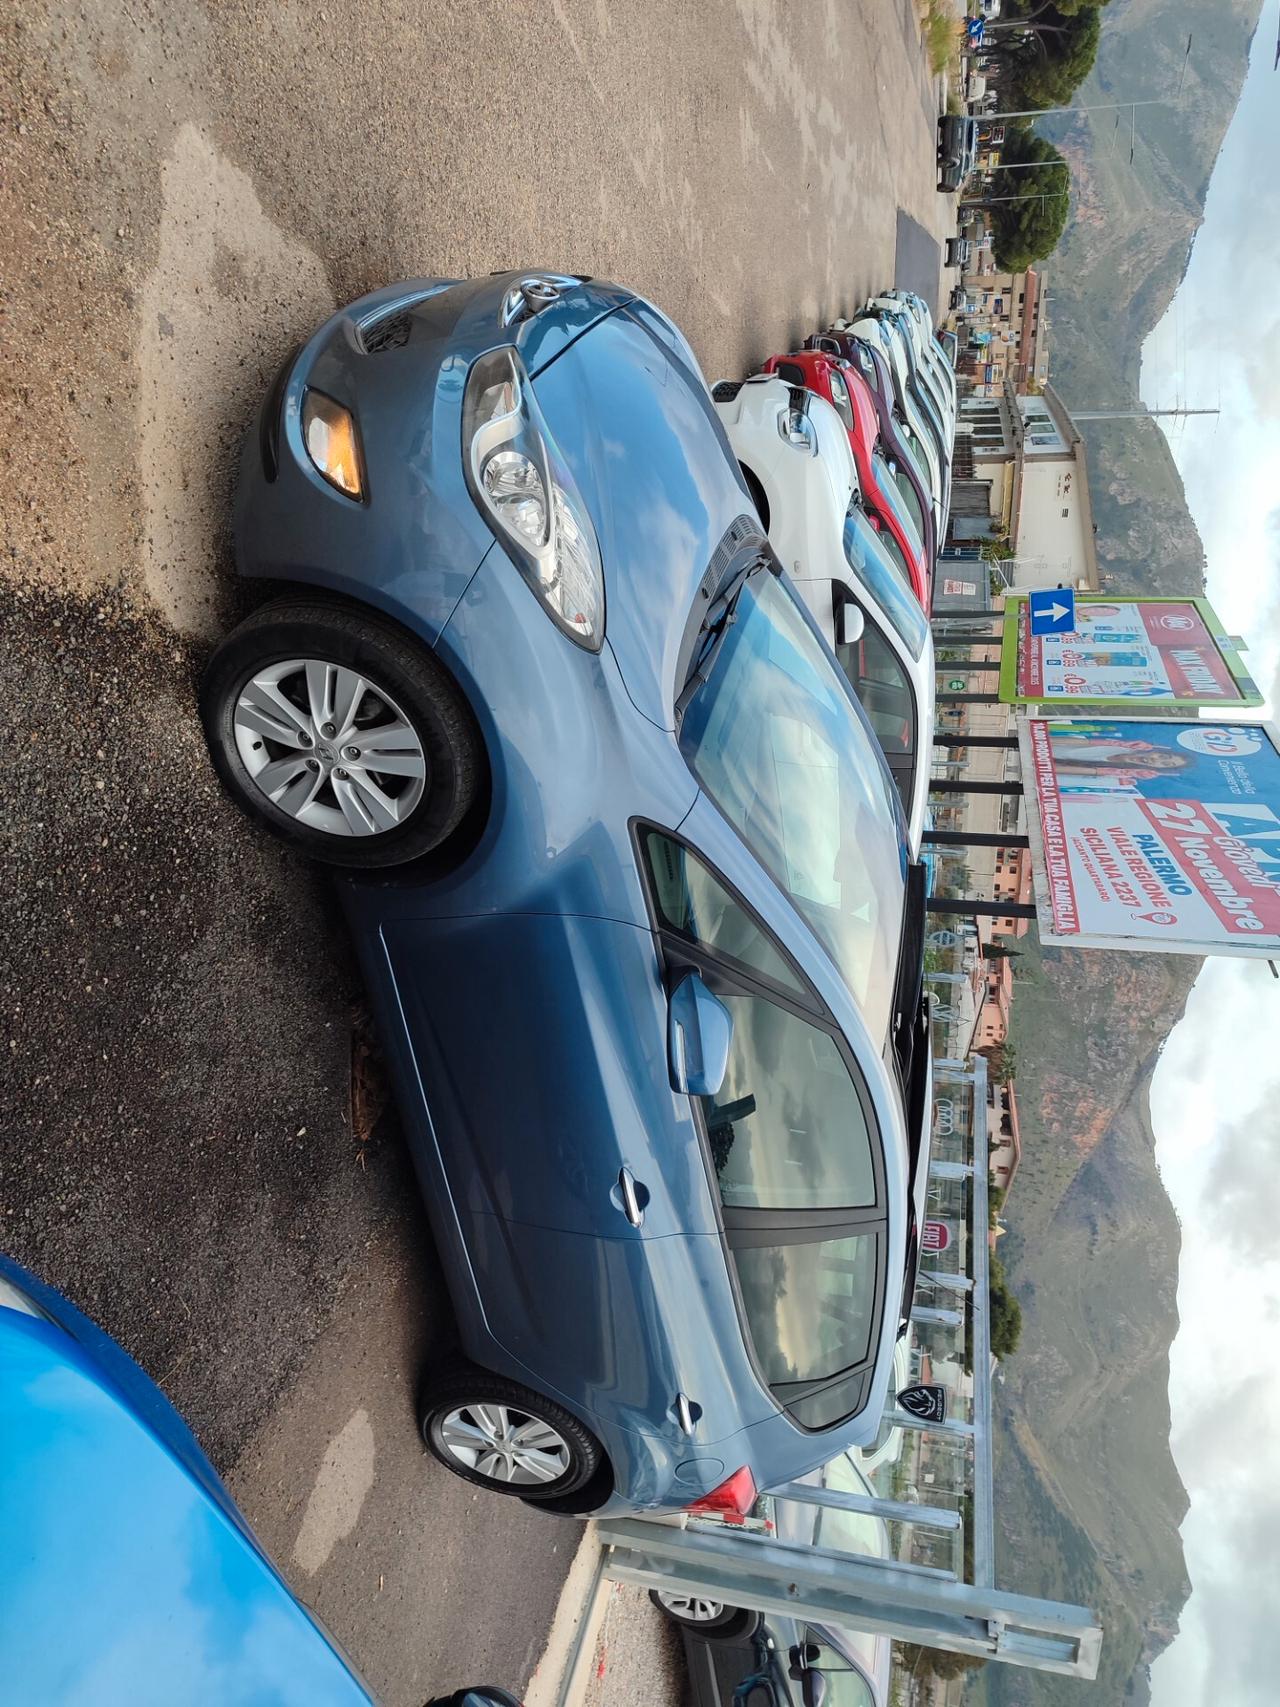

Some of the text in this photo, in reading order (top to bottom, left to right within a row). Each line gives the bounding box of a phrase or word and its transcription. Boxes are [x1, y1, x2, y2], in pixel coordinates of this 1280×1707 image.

[1035, 740, 1052, 772] PRODOTTI
[1040, 773, 1054, 786] PER
[1042, 788, 1056, 797] LA
[1043, 798, 1058, 813] TUA
[1044, 814, 1060, 838] CASA
[1050, 844, 1063, 857] LA
[1050, 858, 1068, 877] TUA
[1080, 828, 1142, 908] SICILIANA 2237
[1106, 827, 1138, 856] VIALE
[1124, 858, 1172, 908] REGIONE
[1132, 834, 1192, 896] PALERMO
[1145, 802, 1264, 930] 27 Novembre
[1052, 879, 1076, 930] FAMIGLIA
[922, 1226, 940, 1248] FIAT
